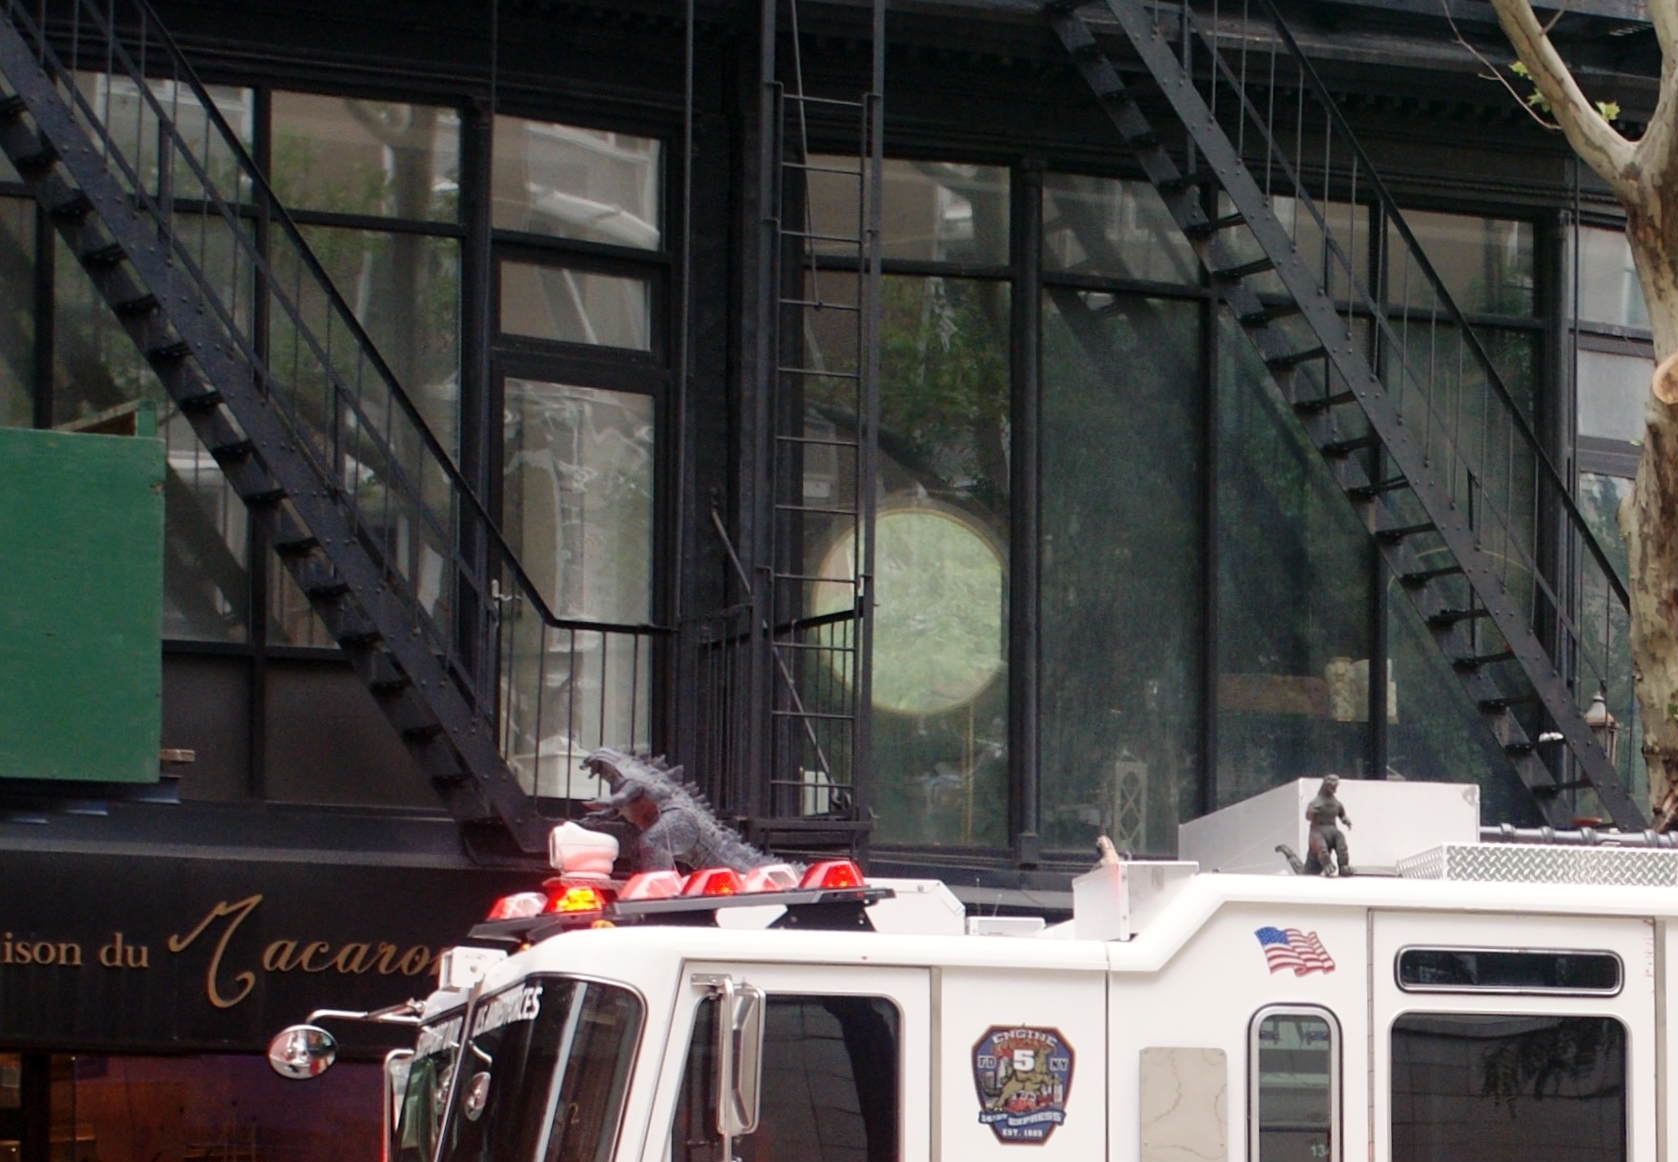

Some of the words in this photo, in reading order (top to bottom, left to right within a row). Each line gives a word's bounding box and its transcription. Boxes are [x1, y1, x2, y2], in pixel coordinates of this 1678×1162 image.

[100, 932, 149, 967] du
[991, 1029, 1058, 1047] ENGINE
[977, 1056, 996, 1069] FD
[1013, 1049, 1035, 1072] 5
[1050, 1058, 1069, 1071] NY
